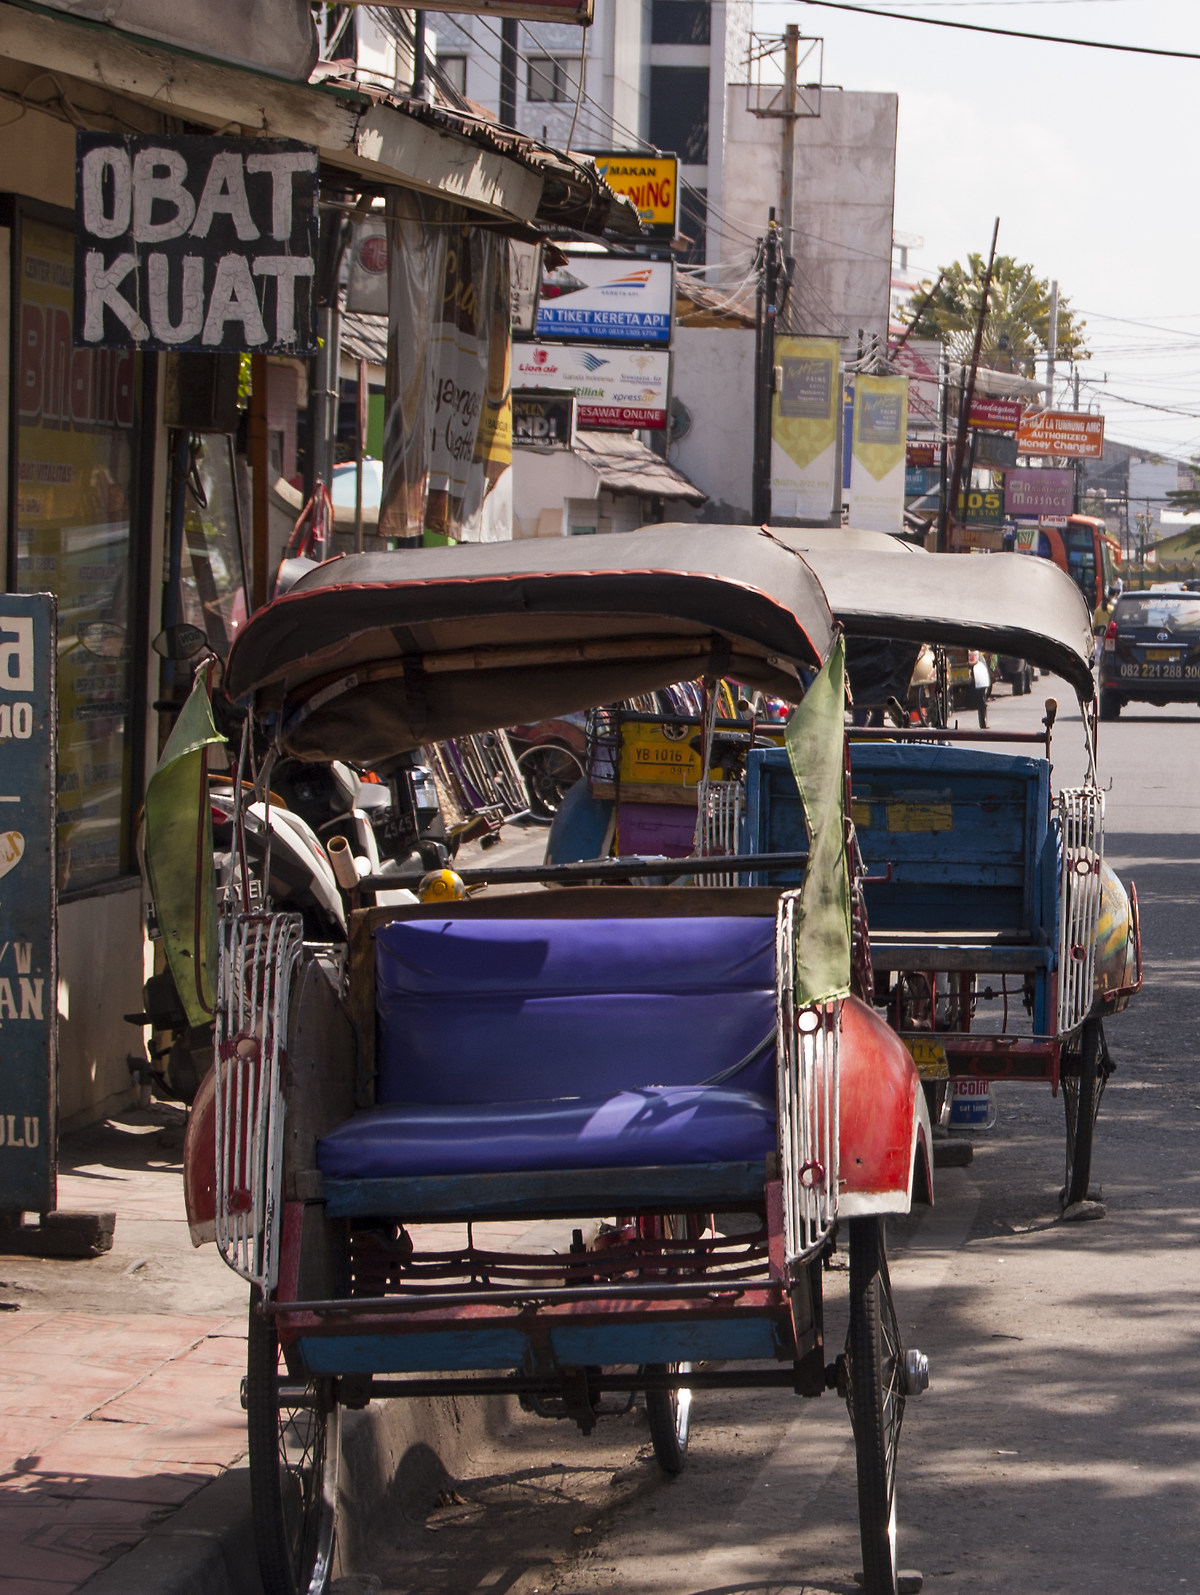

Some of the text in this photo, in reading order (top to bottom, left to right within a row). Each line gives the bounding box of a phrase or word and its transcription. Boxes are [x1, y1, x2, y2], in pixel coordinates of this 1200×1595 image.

[609, 166, 656, 176] MAKAN
[83, 146, 318, 242] OBAT
[83, 252, 316, 346] KUAT
[557, 310, 592, 323] TIKET
[593, 312, 641, 325] KERETA
[643, 314, 666, 327] API
[519, 364, 558, 374] Lion air
[622, 409, 660, 420] ONLINE
[1031, 431, 1088, 442] AUTHORIZED
[1019, 438, 1051, 449] Money
[1053, 441, 1098, 453] Changer
[979, 509, 999, 517] STAY
[1120, 664, 1139, 677] 082
[1142, 664, 1160, 677] 221
[1163, 665, 1182, 678] 288
[635, 748, 650, 761] YB
